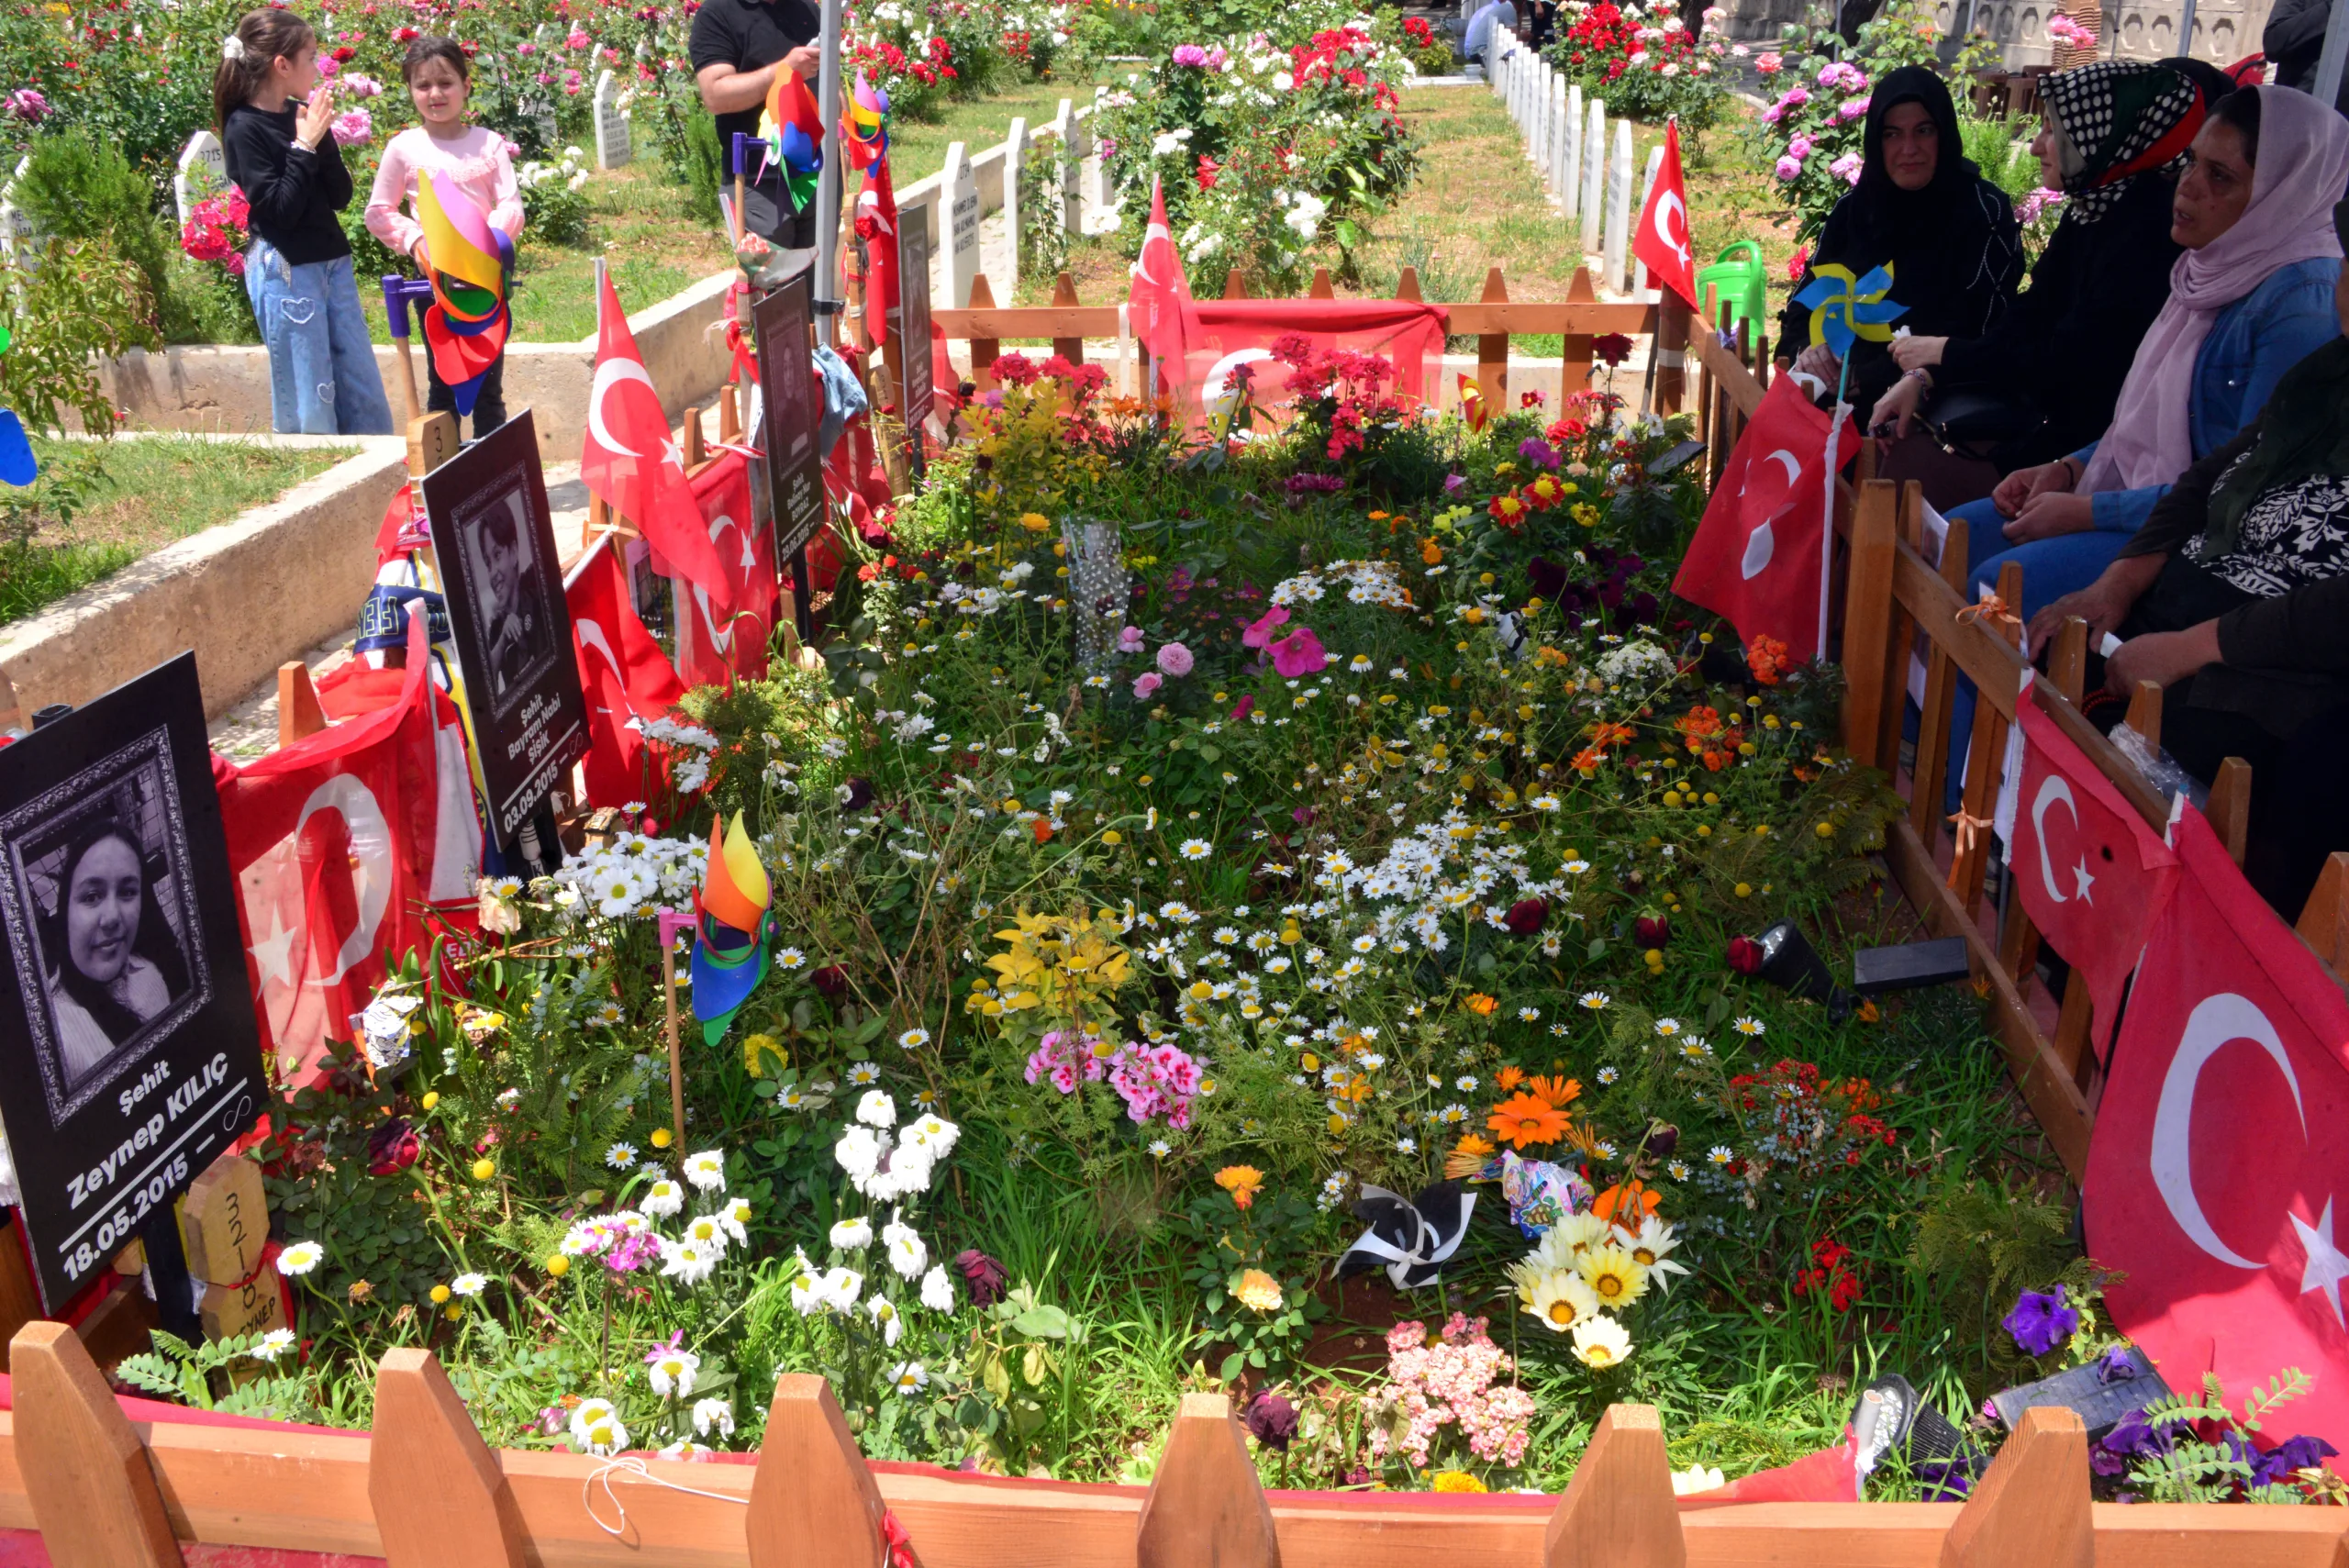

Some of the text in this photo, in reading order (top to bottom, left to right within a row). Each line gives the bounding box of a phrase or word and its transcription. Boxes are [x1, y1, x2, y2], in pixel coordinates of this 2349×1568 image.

[507, 692, 561, 760] Bayram Nabi
[520, 694, 543, 728] Şehit
[504, 759, 558, 833] 03.09.2015
[119, 1060, 172, 1117] Şehit
[66, 1052, 228, 1210] Zeynep KILIÇ
[62, 1152, 189, 1282] 18.05.2015
